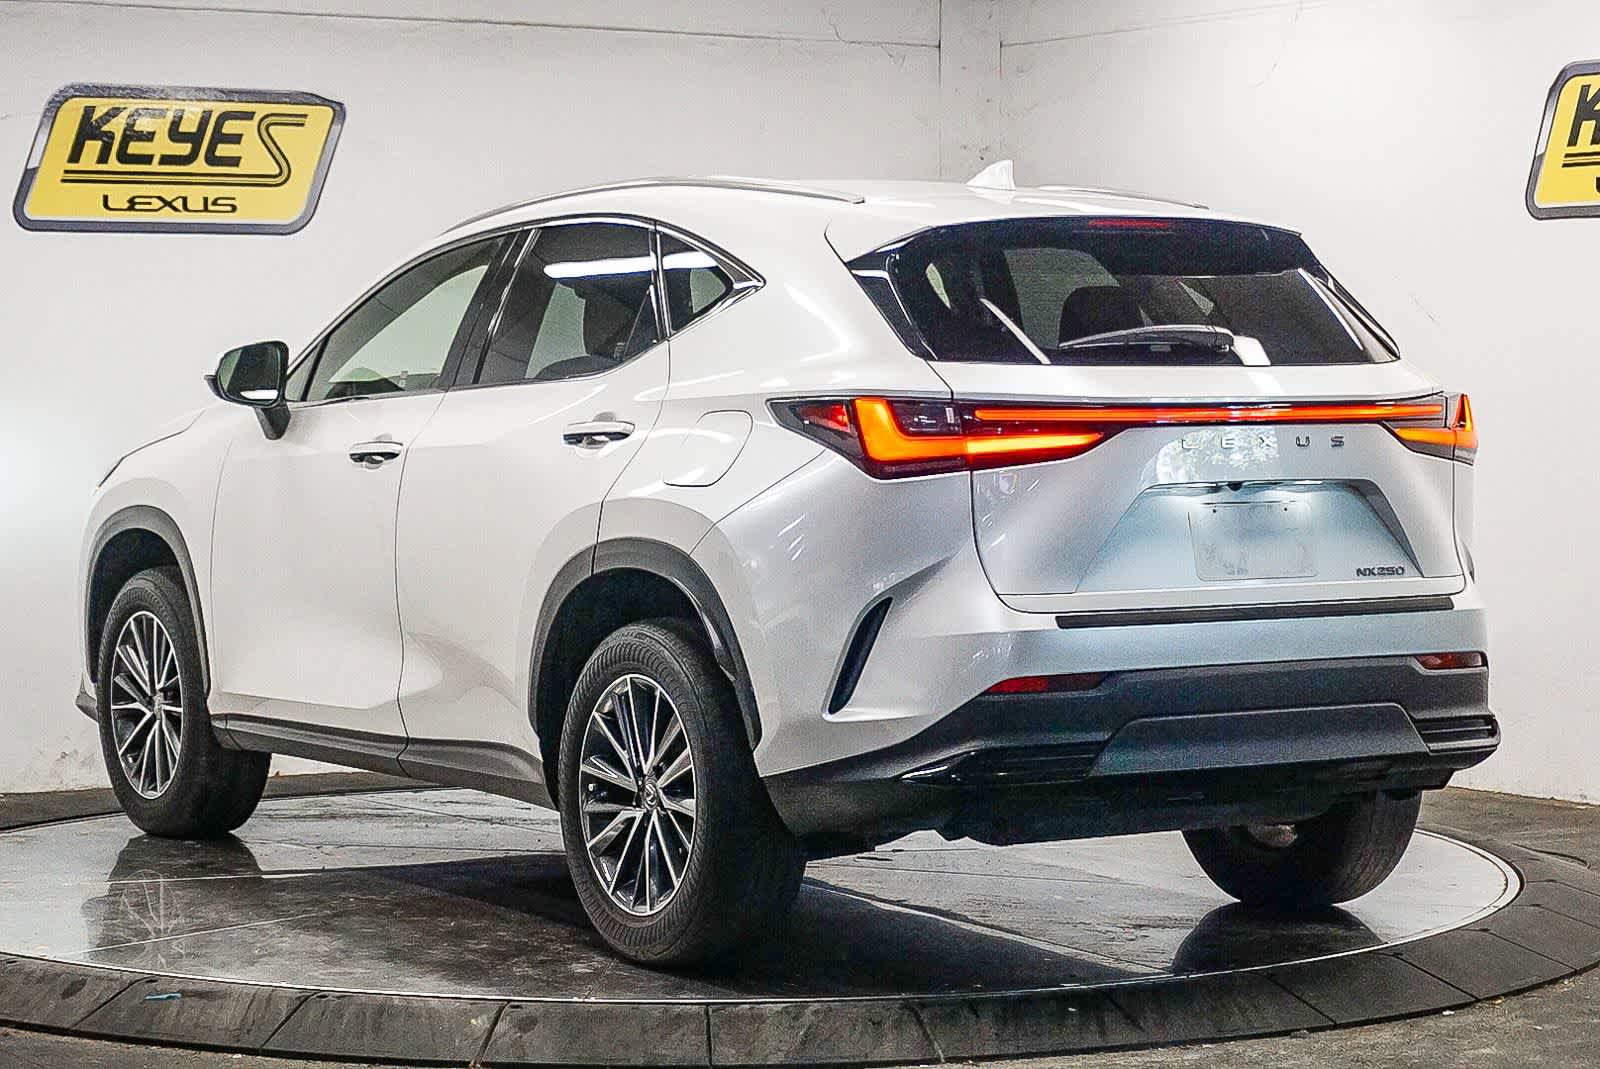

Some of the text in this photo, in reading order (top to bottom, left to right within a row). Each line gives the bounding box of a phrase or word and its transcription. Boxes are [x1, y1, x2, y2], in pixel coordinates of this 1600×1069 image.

[66, 105, 309, 187] KEYES
[102, 194, 238, 213] LEXUS
[1181, 435, 1345, 450] LEXUS
